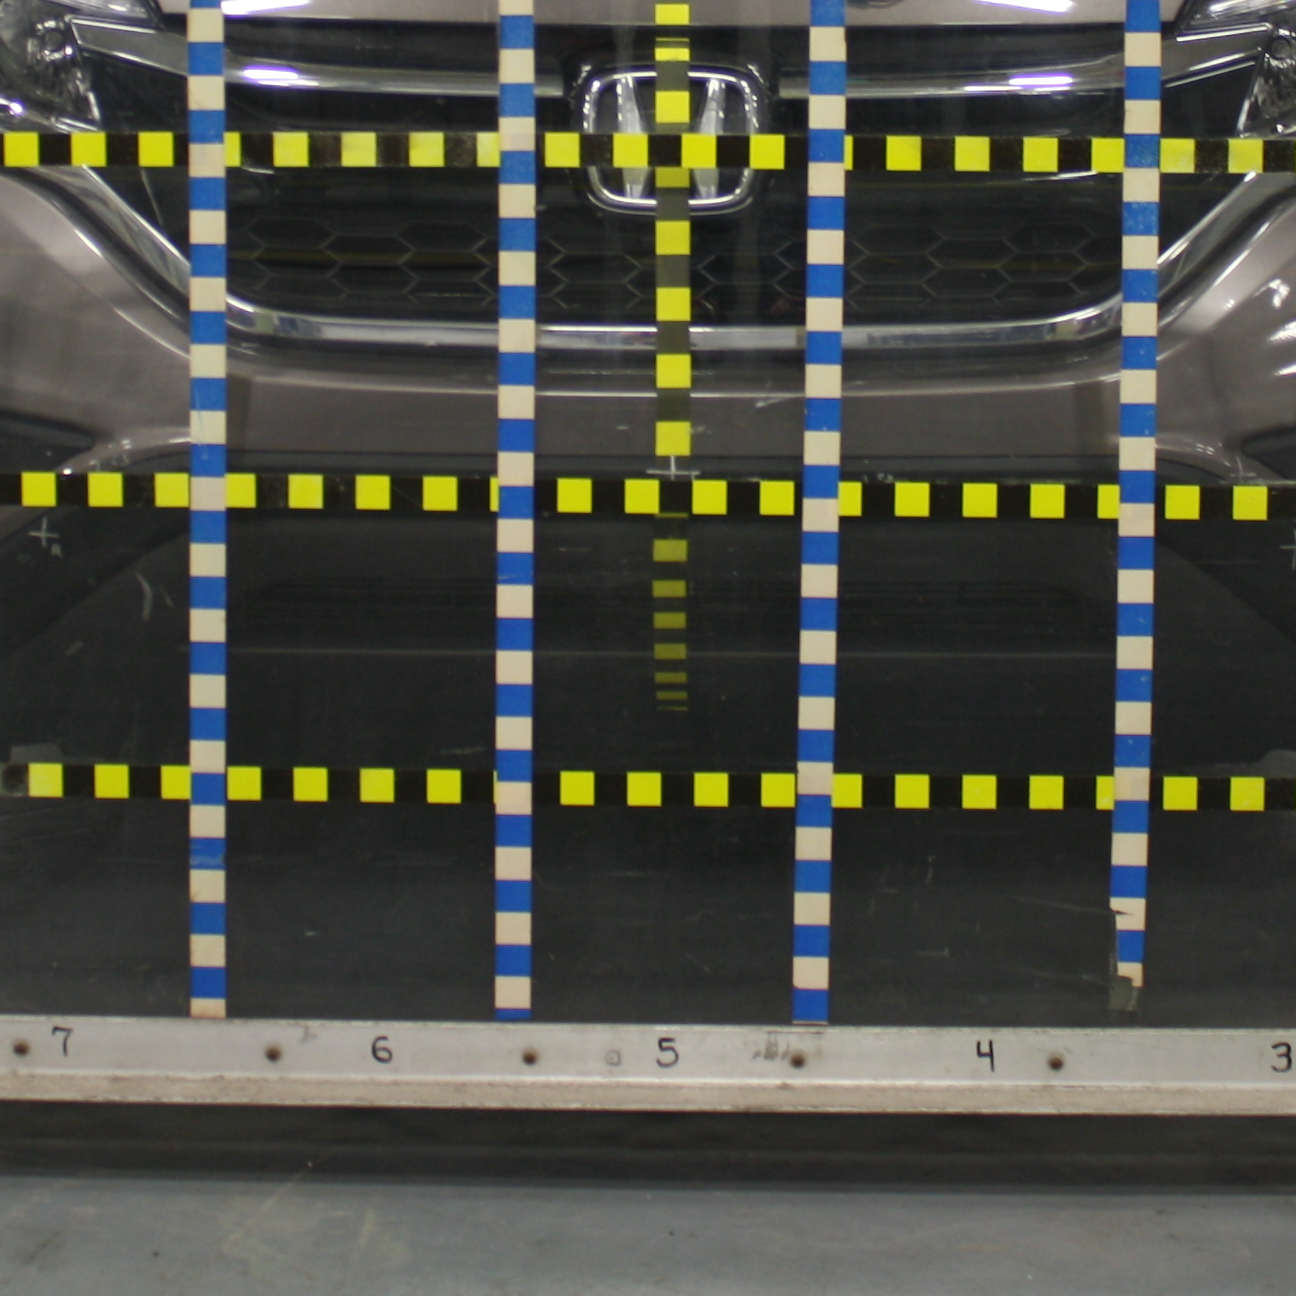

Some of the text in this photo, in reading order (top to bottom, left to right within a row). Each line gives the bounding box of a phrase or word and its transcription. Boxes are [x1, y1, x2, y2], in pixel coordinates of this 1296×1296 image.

[51, 1025, 73, 1056] 7
[371, 1035, 393, 1063] 6
[656, 1037, 679, 1067] 5
[976, 1039, 994, 1071] 4
[1271, 1042, 1293, 1072] 3
